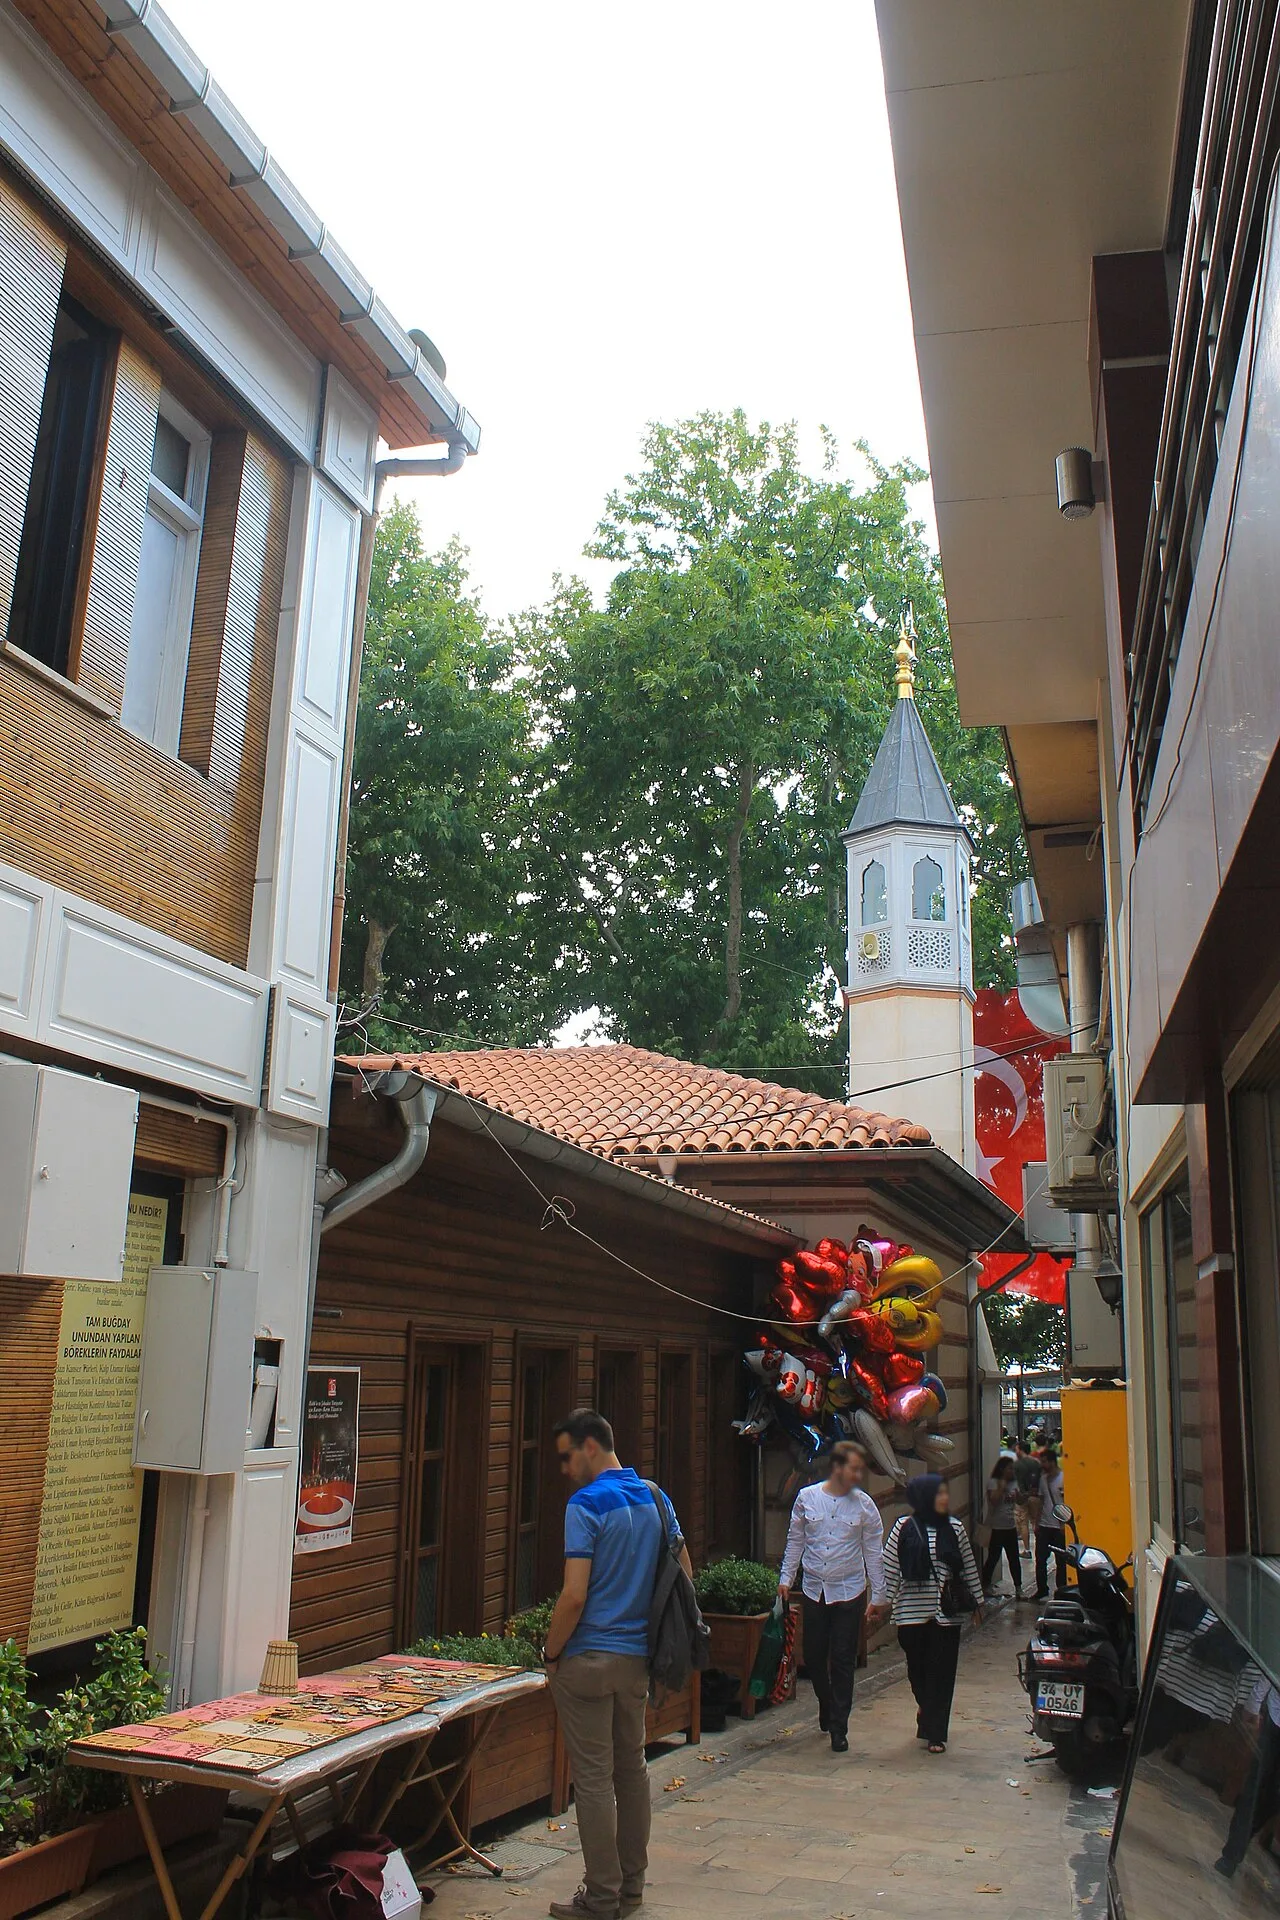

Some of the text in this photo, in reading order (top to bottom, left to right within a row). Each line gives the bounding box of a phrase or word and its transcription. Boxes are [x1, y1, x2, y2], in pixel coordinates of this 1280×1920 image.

[139, 1204, 162, 1218] NEDİR?
[86, 1315, 131, 1328] TAM BUĞDAY
[72, 1331, 141, 1344] UNUNDAN YAPILAN
[63, 1345, 108, 1358] BÖREKLERİN
[1041, 1684, 1082, 1698] 34 UY
[1047, 1696, 1078, 1711] 0546
